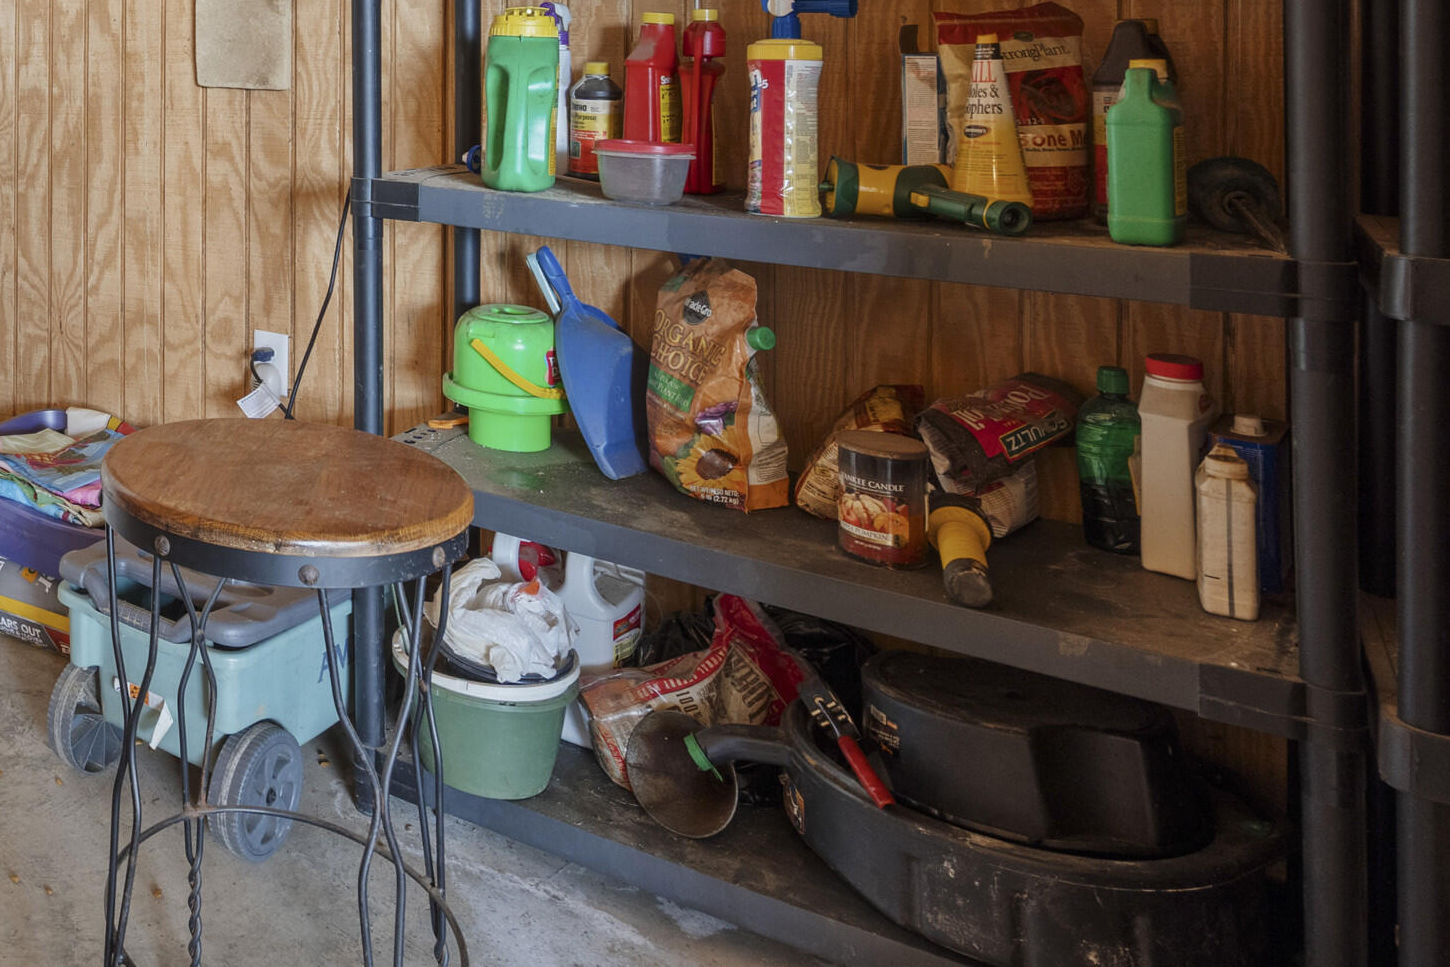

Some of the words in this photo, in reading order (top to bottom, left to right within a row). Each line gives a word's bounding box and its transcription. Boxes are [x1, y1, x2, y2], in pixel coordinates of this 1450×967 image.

[971, 60, 997, 83] ILL
[970, 84, 988, 98] oles
[989, 83, 1000, 98] &
[966, 99, 1003, 119] ophers
[653, 309, 727, 366] ORGANIC
[651, 334, 709, 384] CHOICE
[867, 481, 904, 492] CANDLE
[20, 624, 41, 638] OUT
